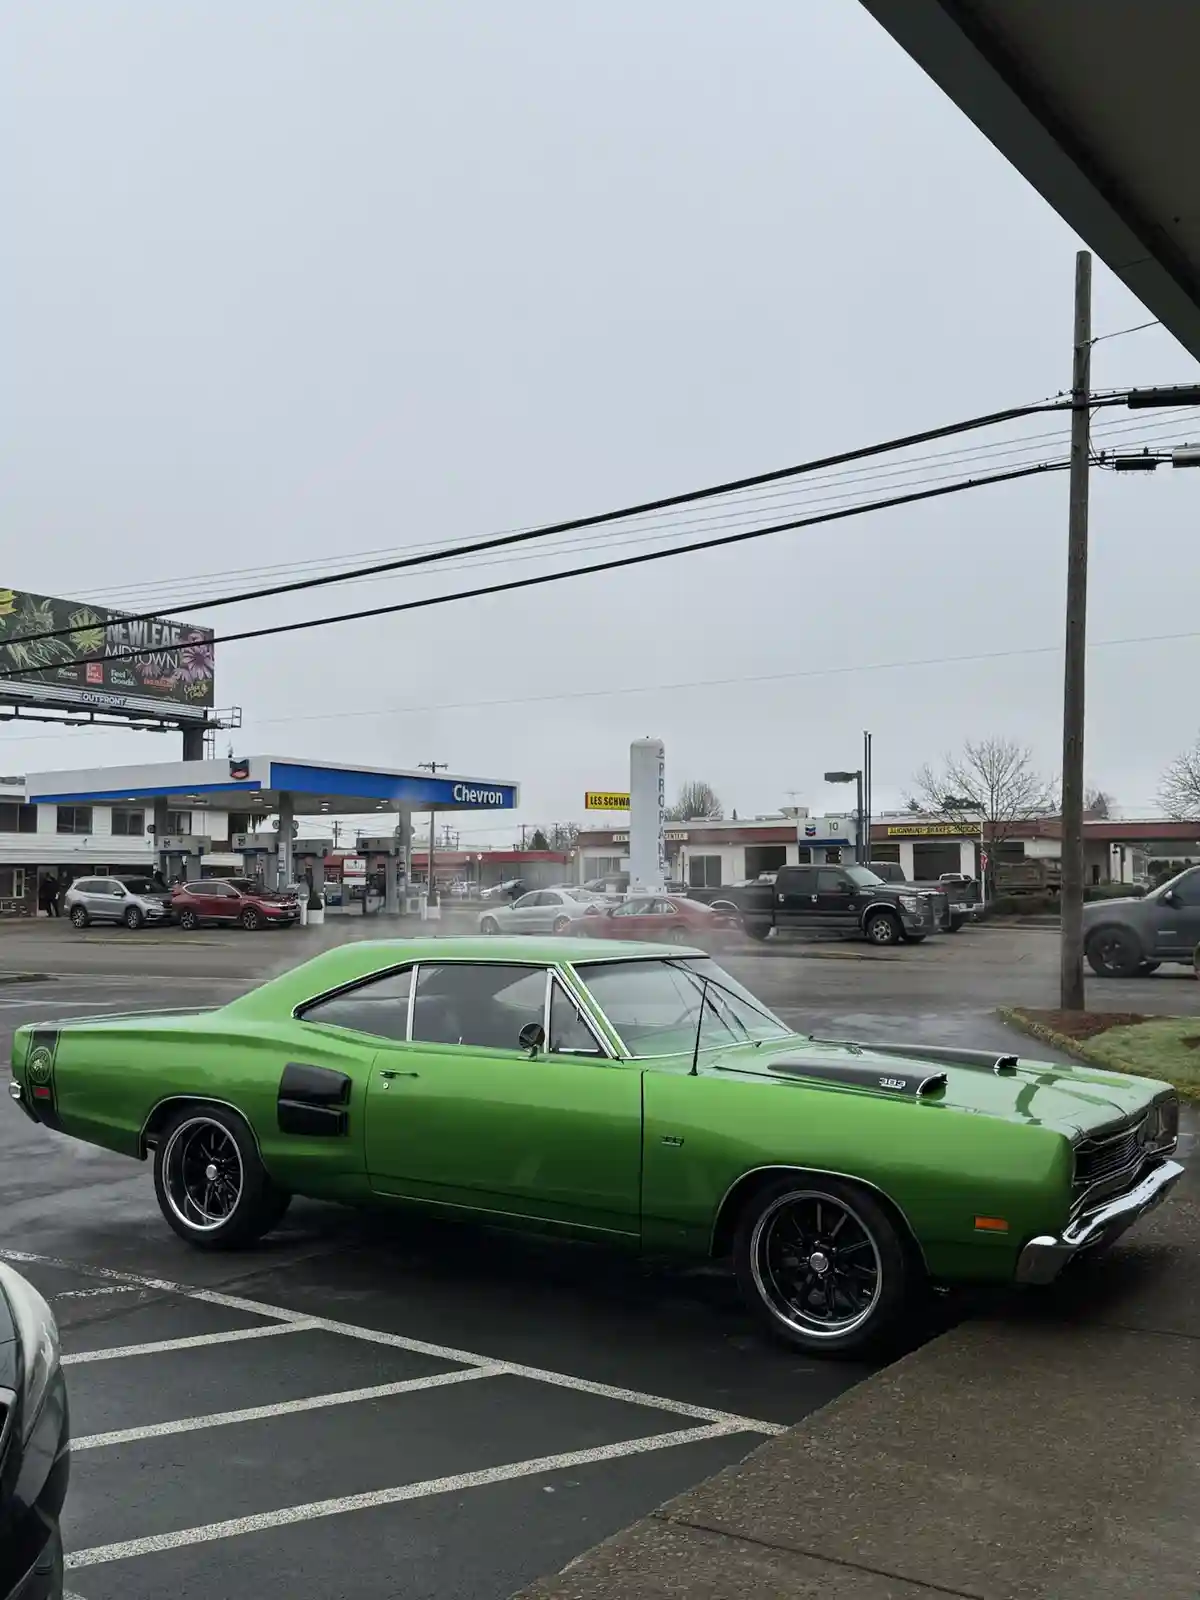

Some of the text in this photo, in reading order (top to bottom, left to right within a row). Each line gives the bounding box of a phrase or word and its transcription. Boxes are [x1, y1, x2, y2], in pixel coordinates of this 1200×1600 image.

[105, 644, 178, 669] MIDTOWN
[83, 693, 127, 706] OUTFRONT
[453, 784, 503, 804] Chevron
[590, 796, 631, 807] LES SCHWA
[829, 822, 839, 831] 10
